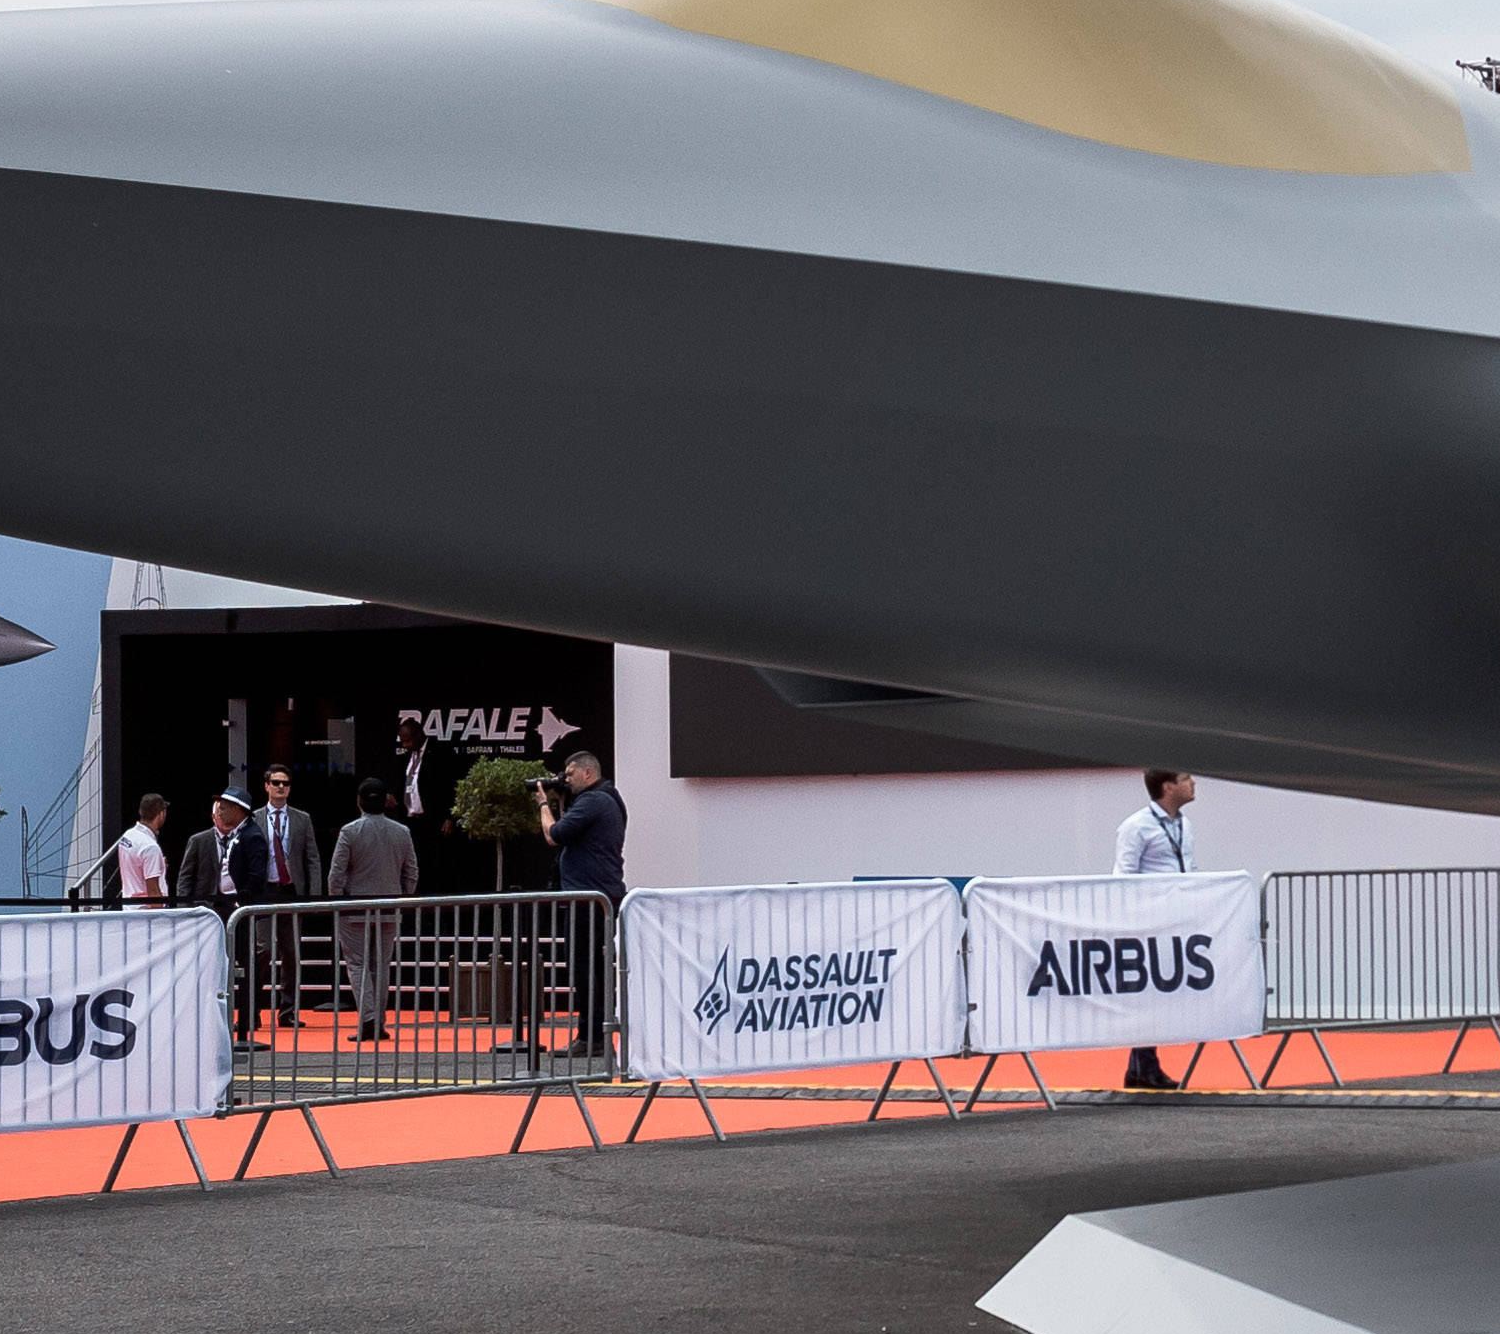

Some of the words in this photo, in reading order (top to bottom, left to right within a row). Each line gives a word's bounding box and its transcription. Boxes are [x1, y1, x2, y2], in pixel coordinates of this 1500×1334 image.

[735, 948, 898, 995] DASSAULT
[1027, 934, 1215, 997] AIRBUS
[734, 988, 885, 1035] AVIATION
